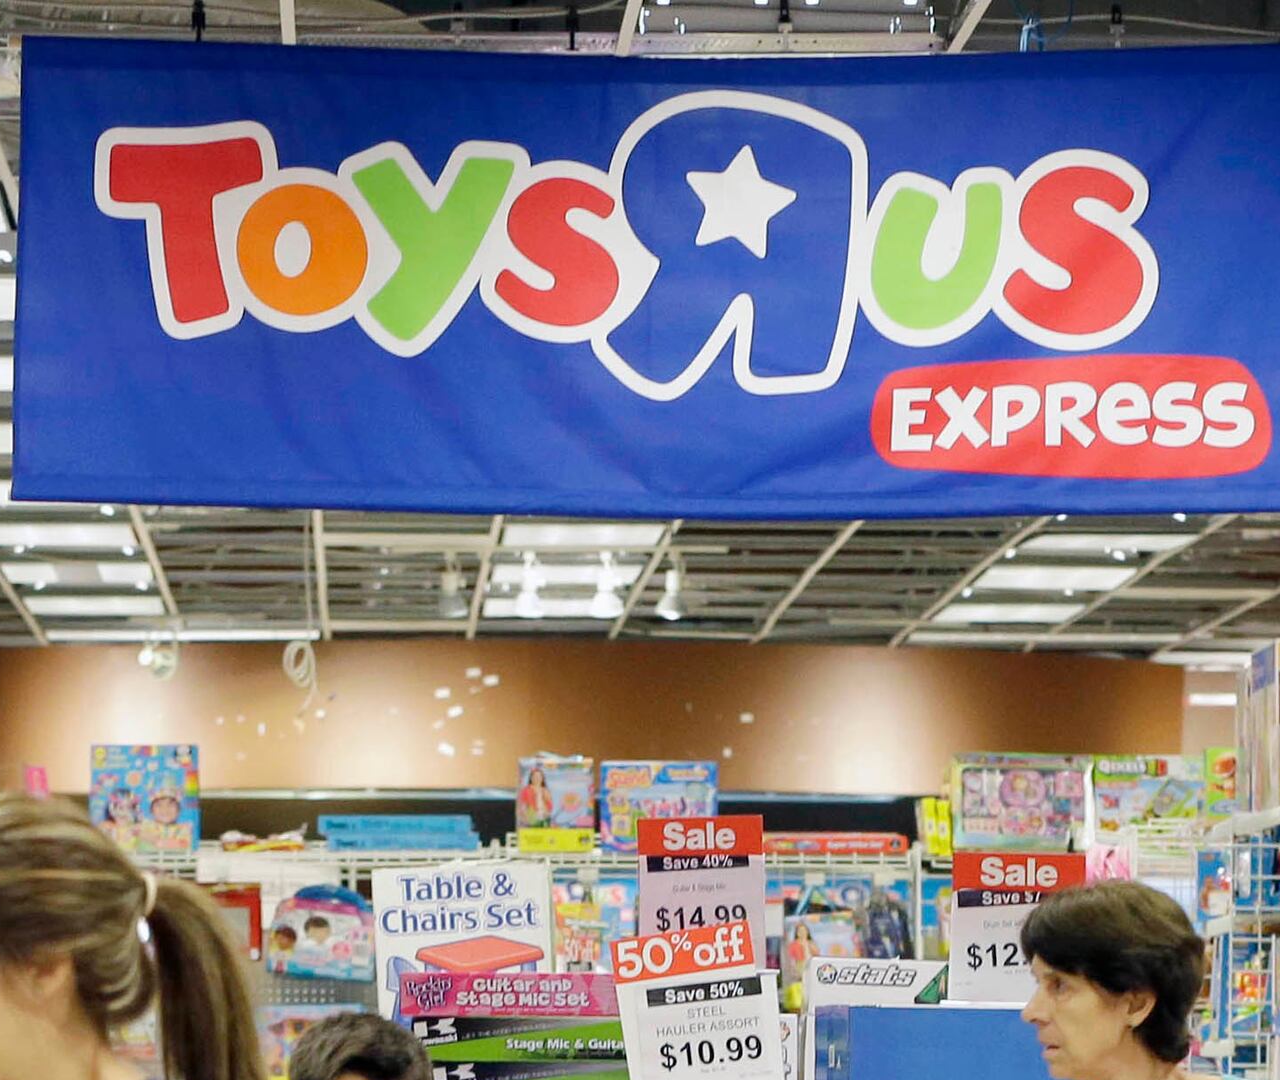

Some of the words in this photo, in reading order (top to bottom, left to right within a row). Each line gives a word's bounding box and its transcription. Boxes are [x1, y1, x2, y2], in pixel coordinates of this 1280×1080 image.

[662, 821, 736, 851] Sale
[663, 856, 699, 870] Save
[701, 855, 733, 868] 40%
[980, 856, 1058, 887] Sale
[400, 875, 483, 901] Table
[493, 872, 516, 897] &
[981, 891, 1020, 906] Save
[381, 906, 477, 934] Chairs
[486, 902, 537, 929] Set
[617, 931, 692, 979] 50%
[693, 925, 745, 968] off
[472, 978, 534, 994] Guitar
[837, 963, 917, 987] stats
[664, 987, 705, 1004] Save
[709, 981, 744, 999] 50%
[687, 1006, 727, 1020] STEEL
[656, 1023, 707, 1038] HAULER
[710, 1016, 761, 1029] ASSORT
[422, 1033, 458, 1046] awasaki
[506, 1038, 545, 1052] Stage
[547, 1038, 571, 1050] Mic
[574, 1039, 586, 1050] &
[588, 1038, 626, 1050] Guita
[659, 1034, 763, 1072] $10.99
